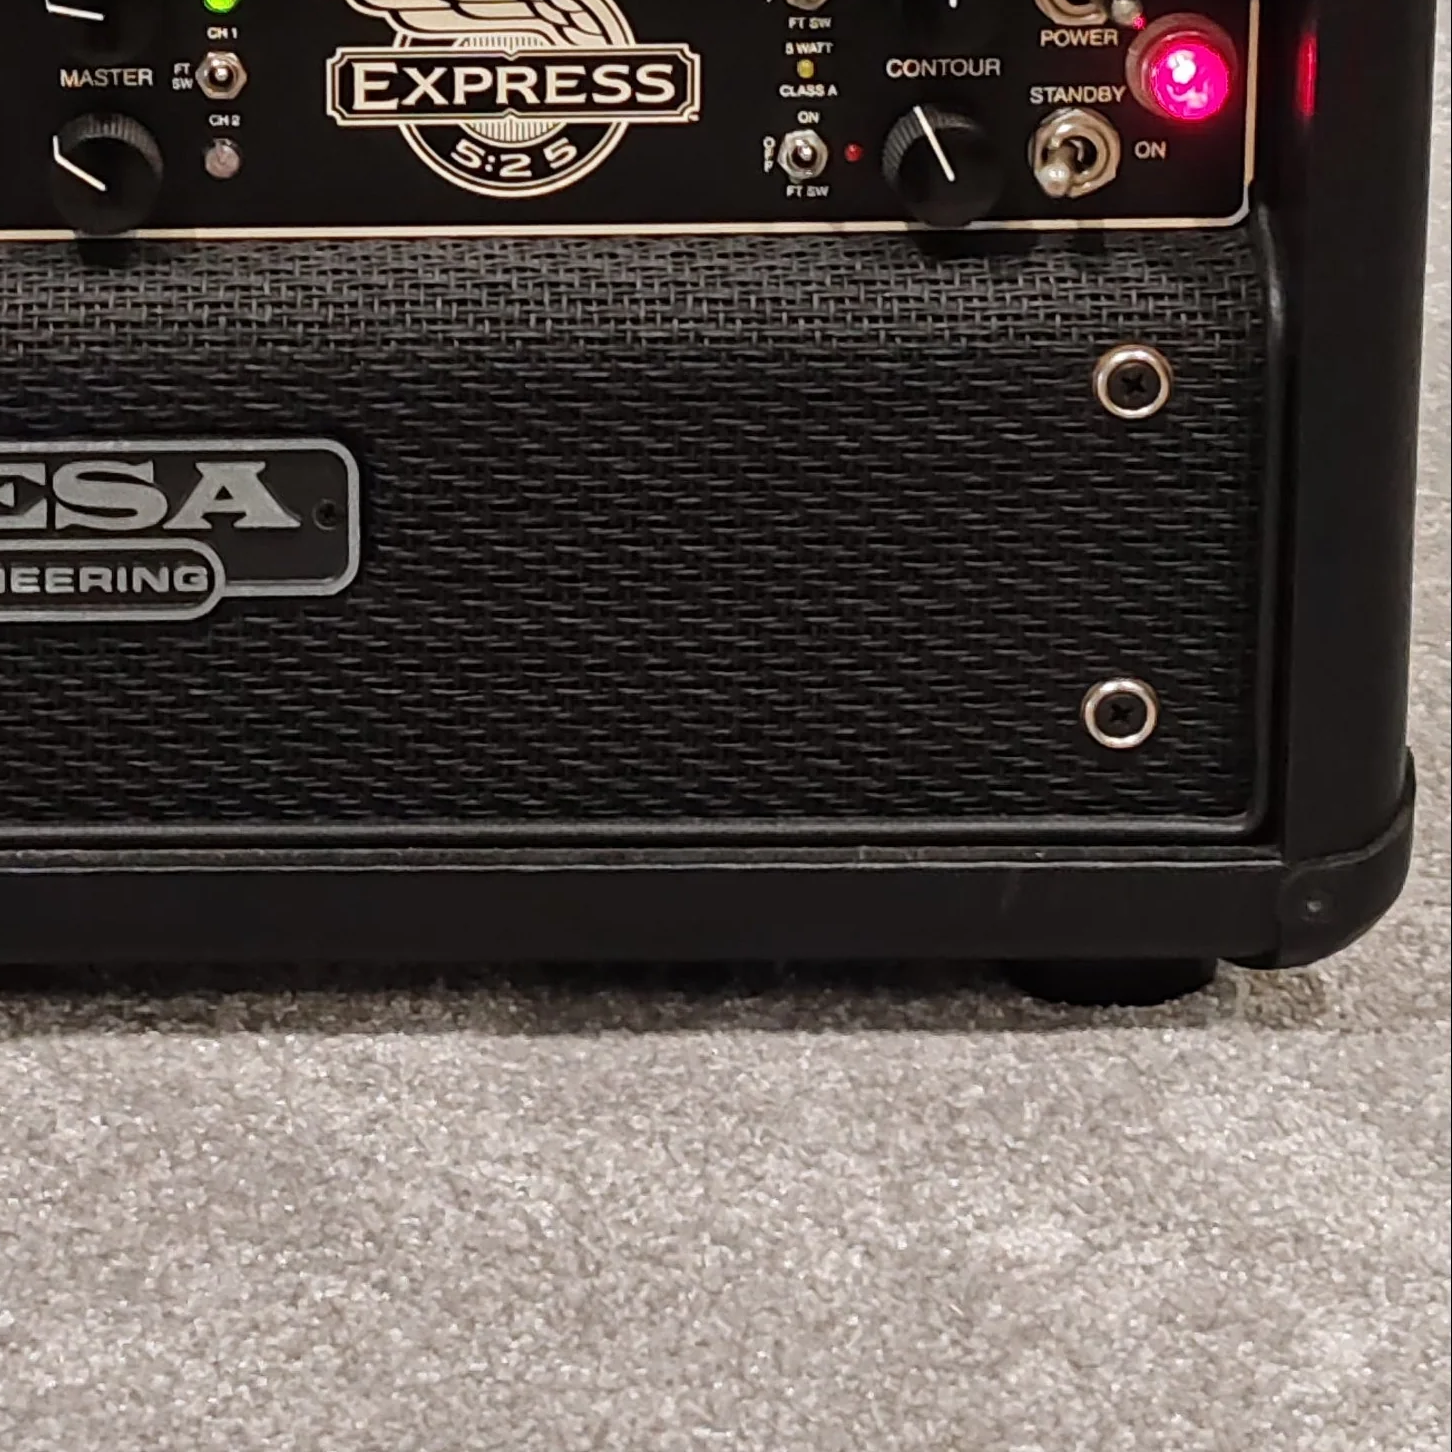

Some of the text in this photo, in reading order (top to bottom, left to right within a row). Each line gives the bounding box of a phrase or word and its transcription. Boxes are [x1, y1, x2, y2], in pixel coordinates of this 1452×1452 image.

[1040, 28, 1119, 47] POWER
[59, 68, 154, 89] MASTER
[885, 57, 1001, 79] CONTOUR
[351, 61, 676, 111] EXPRESS
[779, 84, 838, 98] CLASS A
[1029, 84, 1127, 105] STANDBY
[797, 111, 820, 124] ON
[450, 136, 578, 178] 5:25
[1134, 141, 1166, 159] ON
